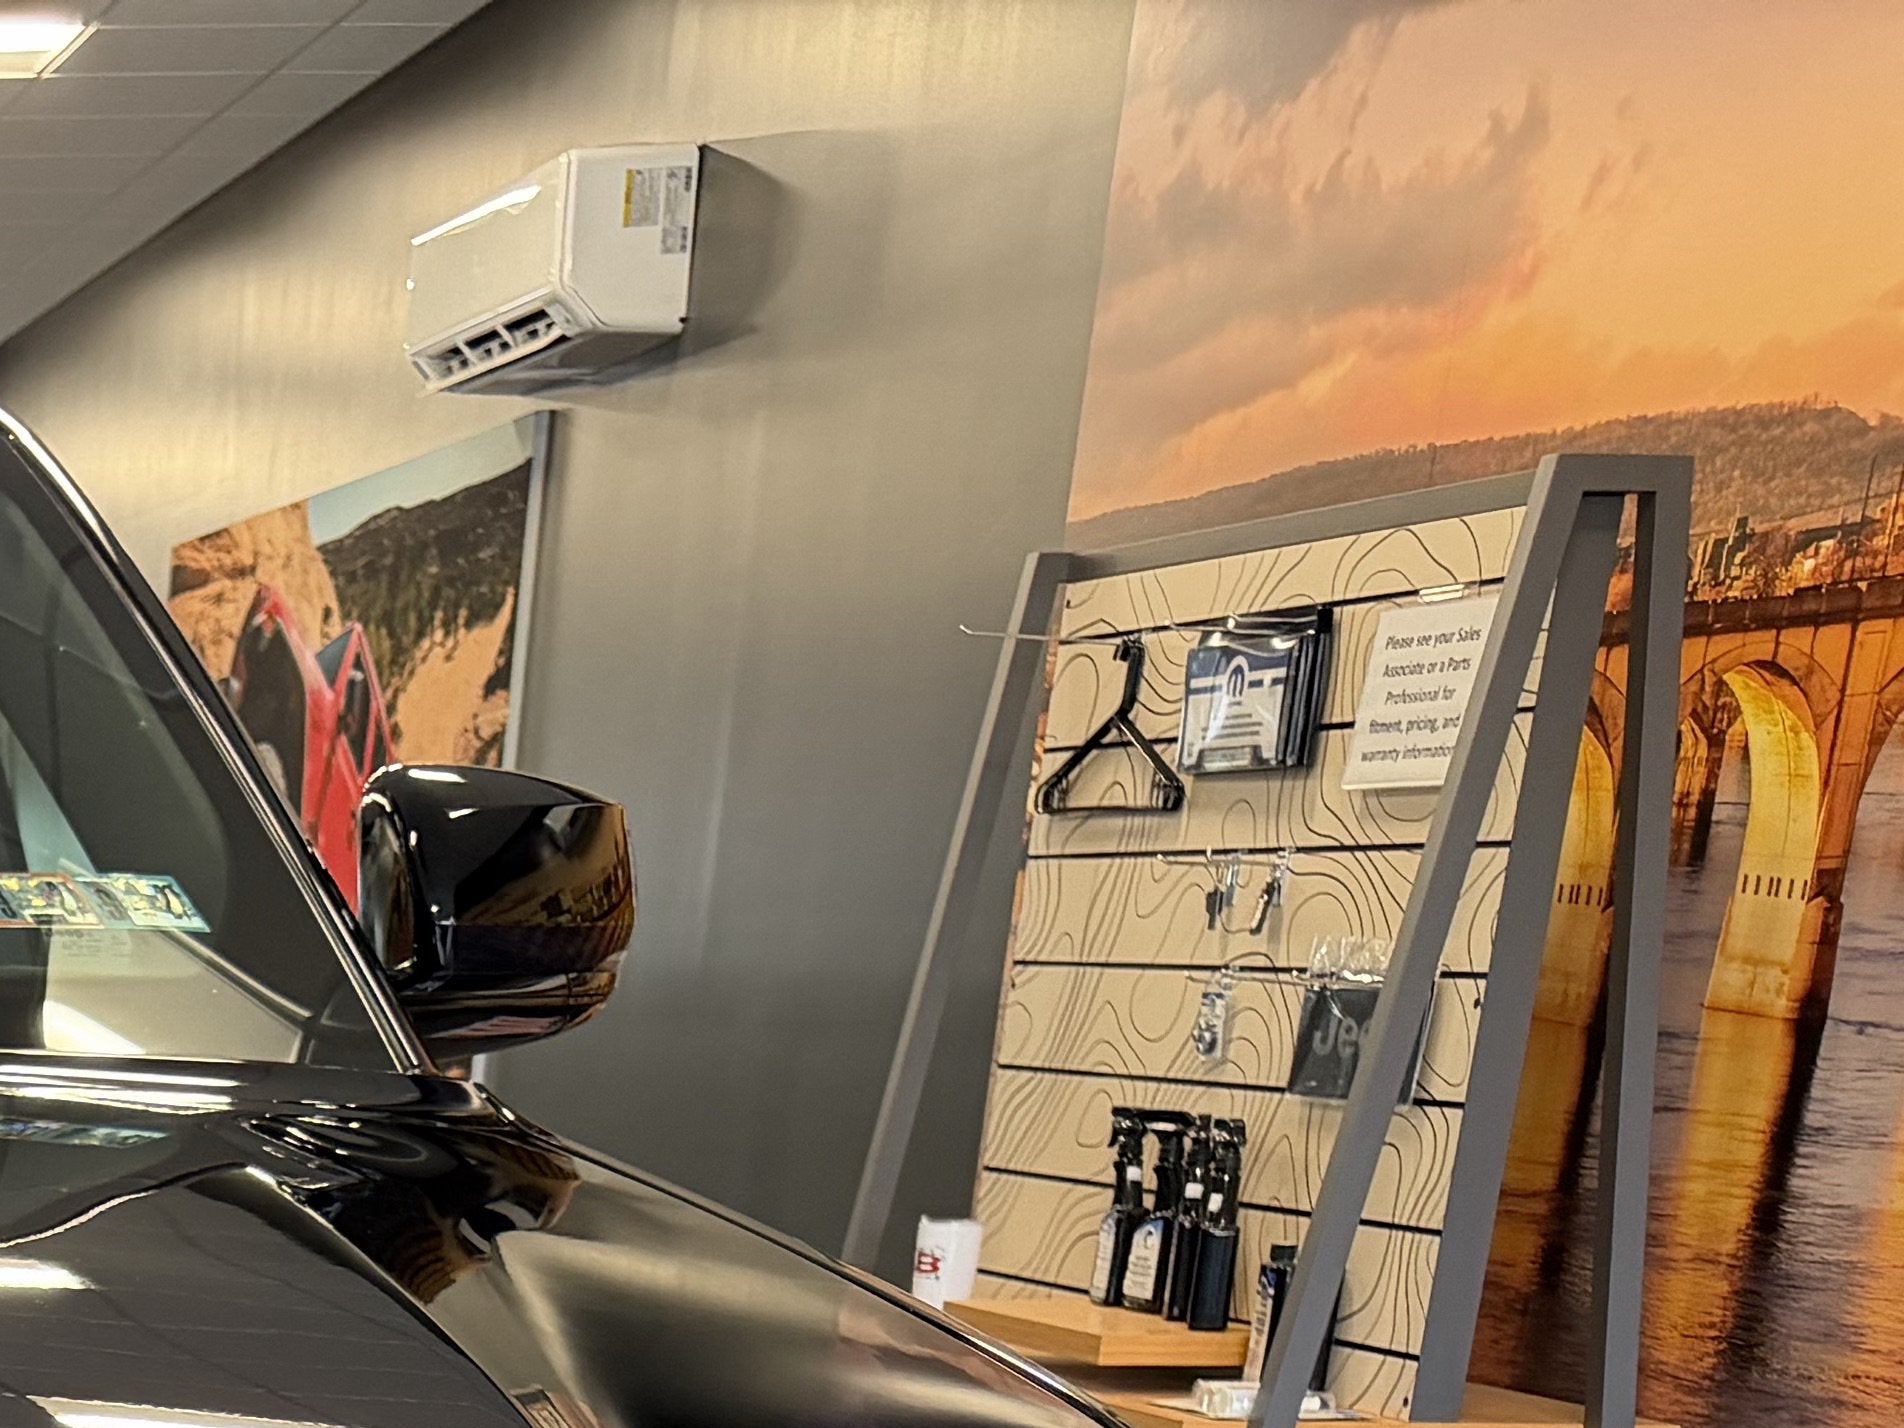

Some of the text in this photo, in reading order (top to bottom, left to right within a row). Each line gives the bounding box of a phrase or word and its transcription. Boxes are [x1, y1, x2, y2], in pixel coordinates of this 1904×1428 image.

[1385, 626, 1482, 651] Please see your Sales
[1382, 656, 1472, 678] Associate or a Parts
[1384, 684, 1457, 705] Professional for
[1405, 714, 1440, 736] pricing,
[1442, 712, 1462, 730] and
[1360, 748, 1401, 763] warranty
